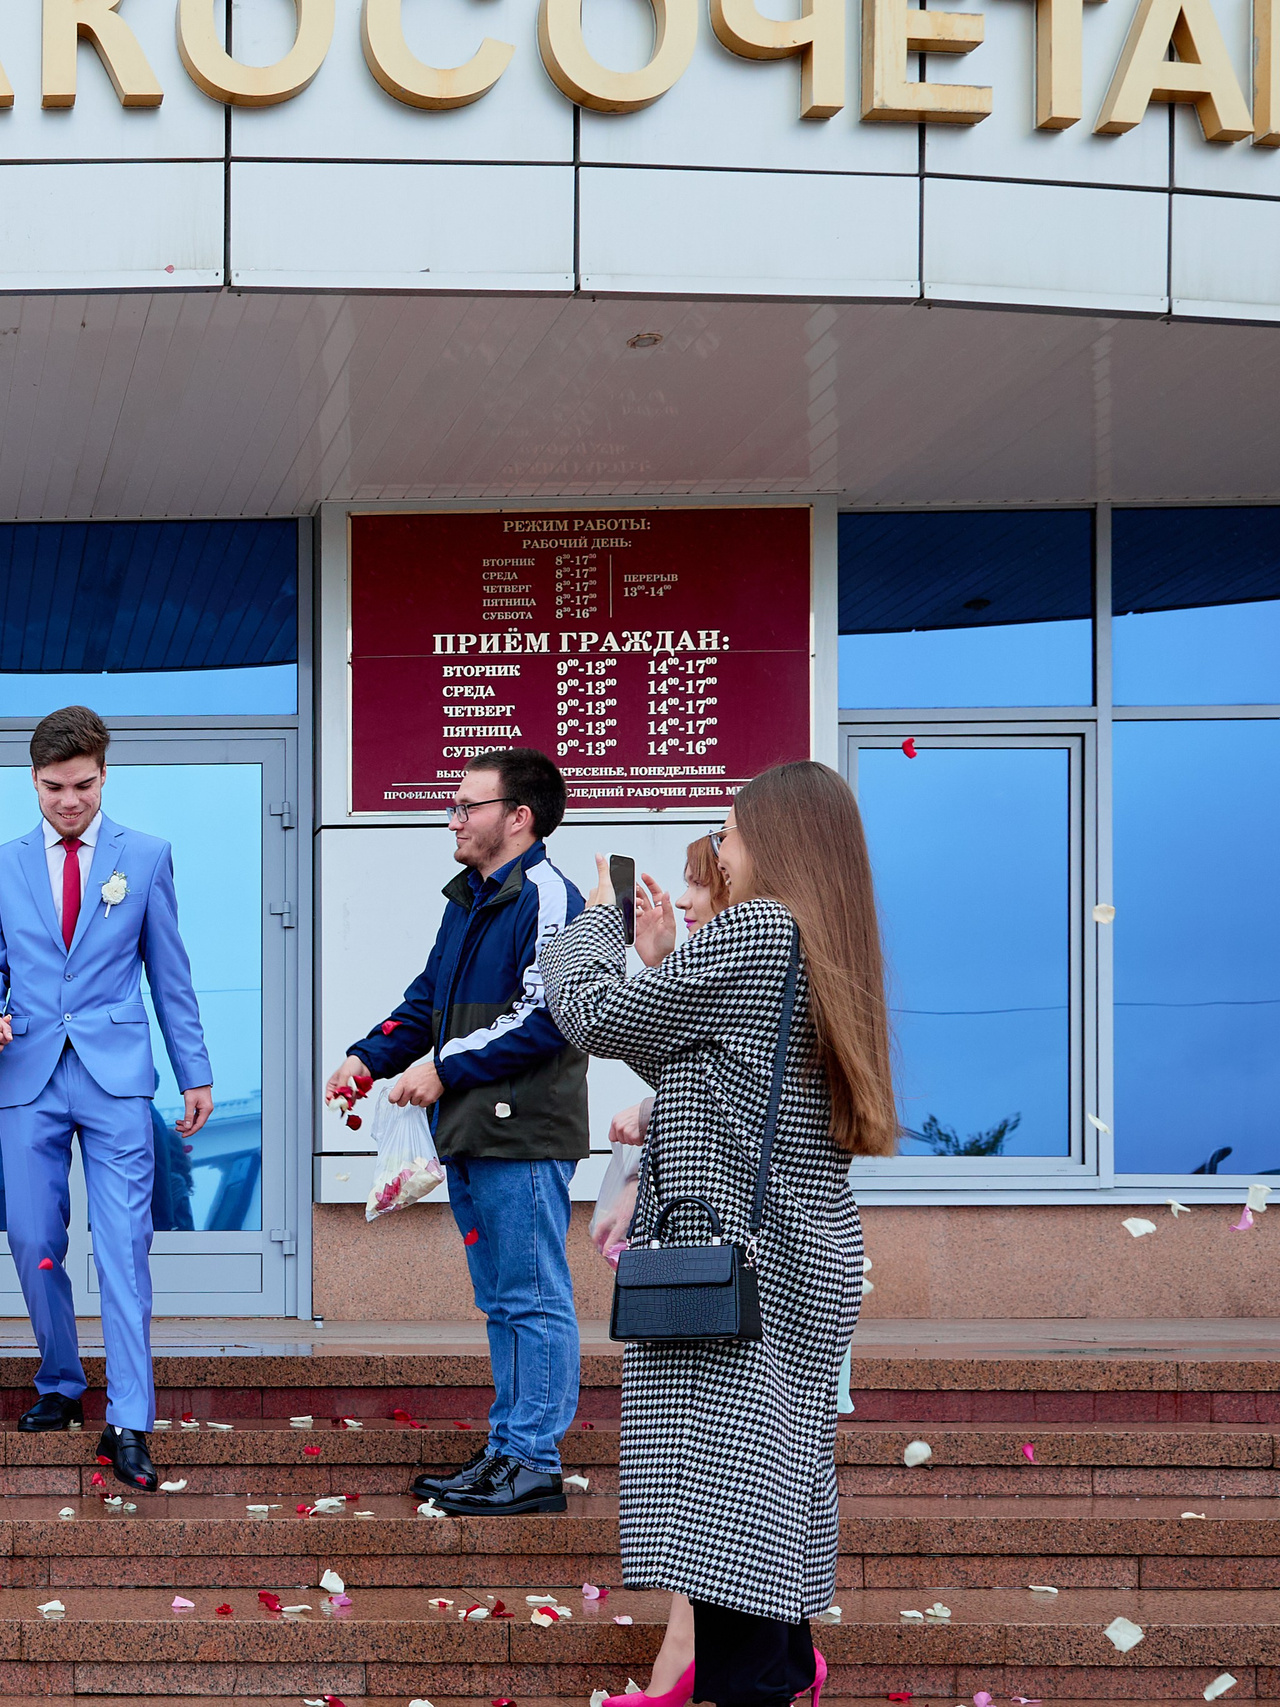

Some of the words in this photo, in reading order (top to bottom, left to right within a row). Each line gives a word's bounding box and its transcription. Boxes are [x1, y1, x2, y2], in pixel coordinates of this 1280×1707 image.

[503, 520, 569, 532] РЕЖИМ
[573, 519, 651, 531] РАБОТЫ:
[522, 537, 588, 548] РАБОЧИЙ
[590, 538, 632, 549] ДЕНЬ:
[482, 557, 536, 567] ВТОРНИК
[482, 571, 519, 581] СРЕДА
[623, 573, 679, 583] ПЕРЕРЫВ
[482, 584, 532, 594] ЧЕТВЕРГ
[482, 598, 537, 607] ПЯТНИЦА
[482, 611, 533, 621] СУББОТА
[433, 628, 550, 654] ПРИЁМ
[559, 630, 729, 657] ГРАЖДАН:
[442, 665, 521, 677] ВТОРНИК
[442, 686, 496, 699] СРЕДА
[442, 705, 516, 717] ЧЕТВЕРГ
[442, 726, 523, 739] ПЯТНИЦА
[558, 767, 628, 776] КРЕСЕНЬЕ,
[629, 766, 726, 777] ПОНЕДЕЛЬНИК
[688, 787, 724, 797] ДЕНЬ
